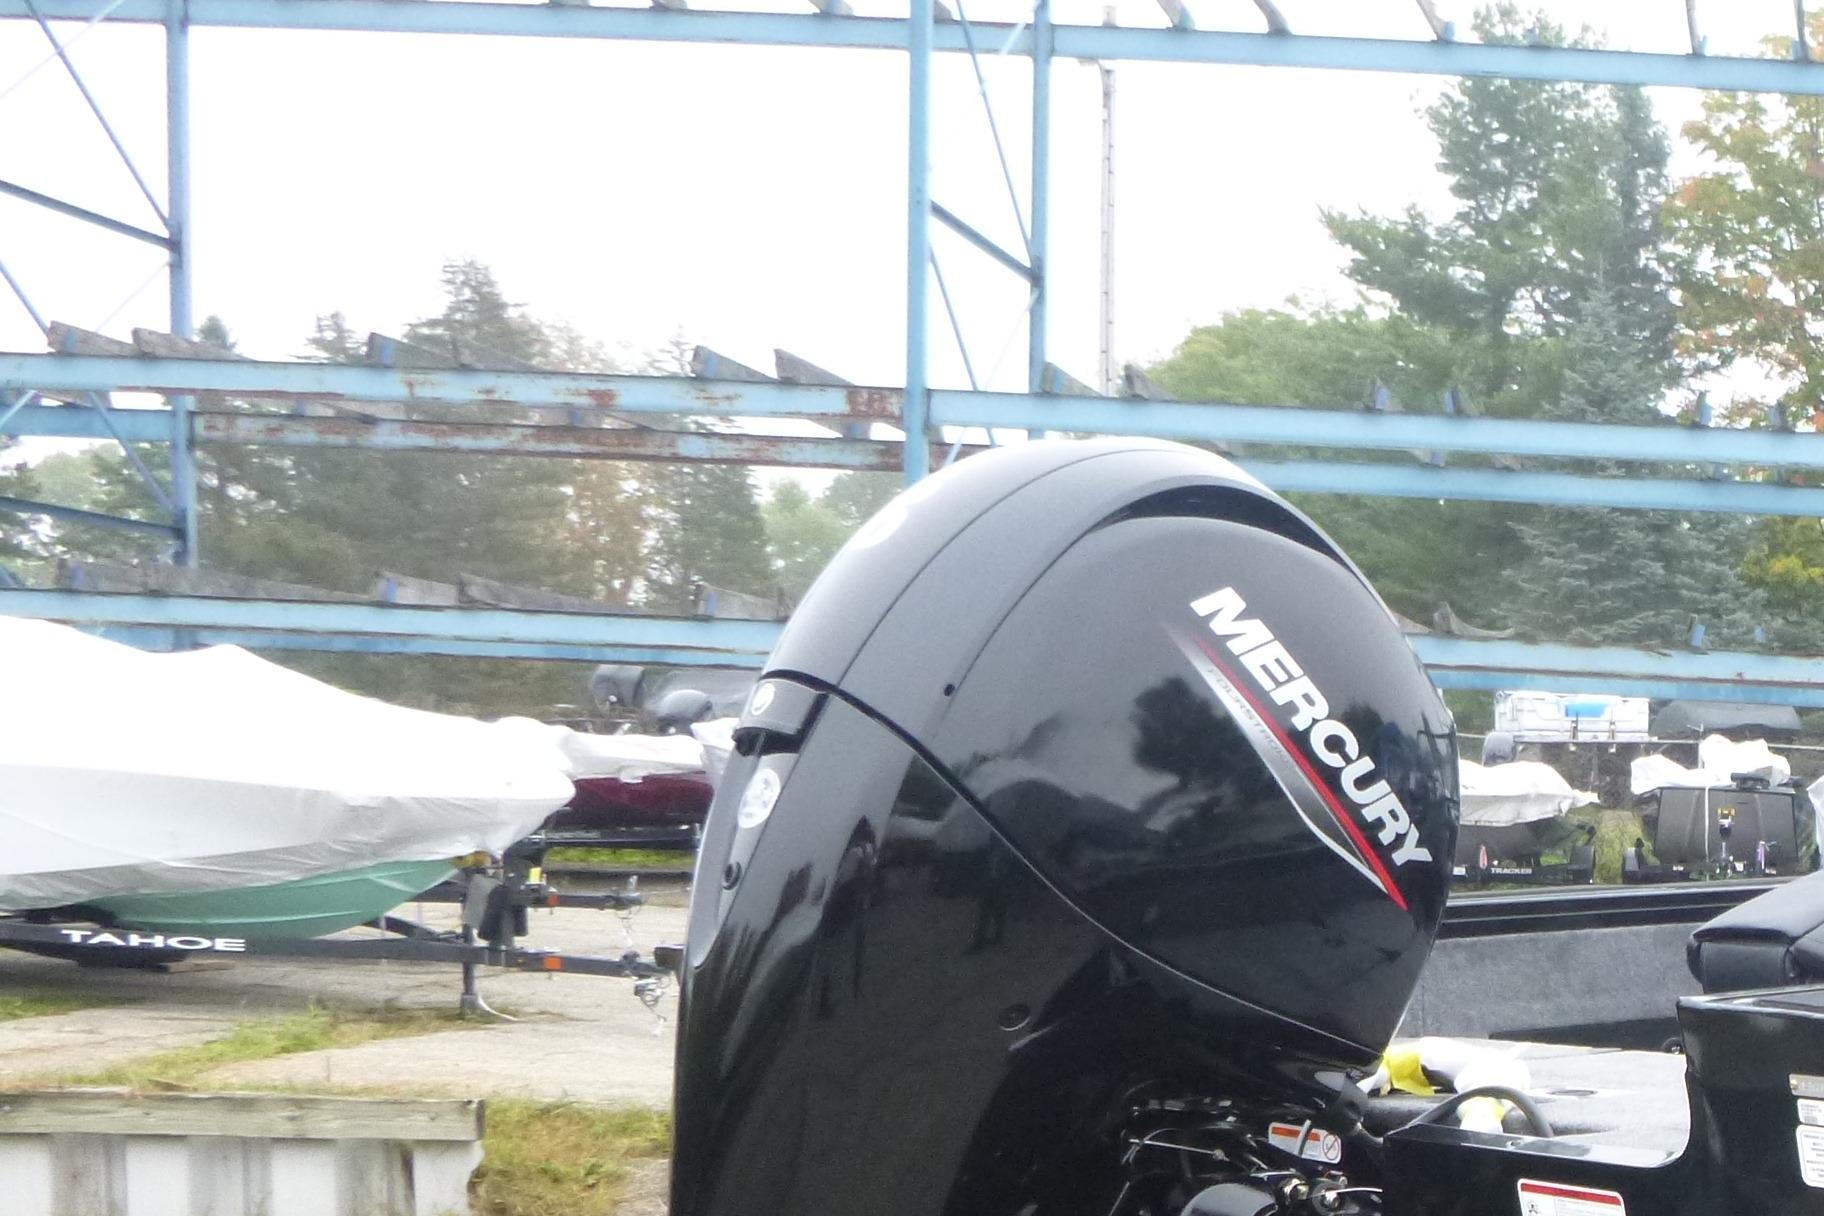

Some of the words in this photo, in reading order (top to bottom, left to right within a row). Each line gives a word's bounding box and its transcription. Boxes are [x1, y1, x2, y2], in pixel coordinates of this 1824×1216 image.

[1190, 586, 1432, 866] MERCURY
[1205, 663, 1288, 762] FOURSTRO
[61, 929, 246, 952] TAHOE
